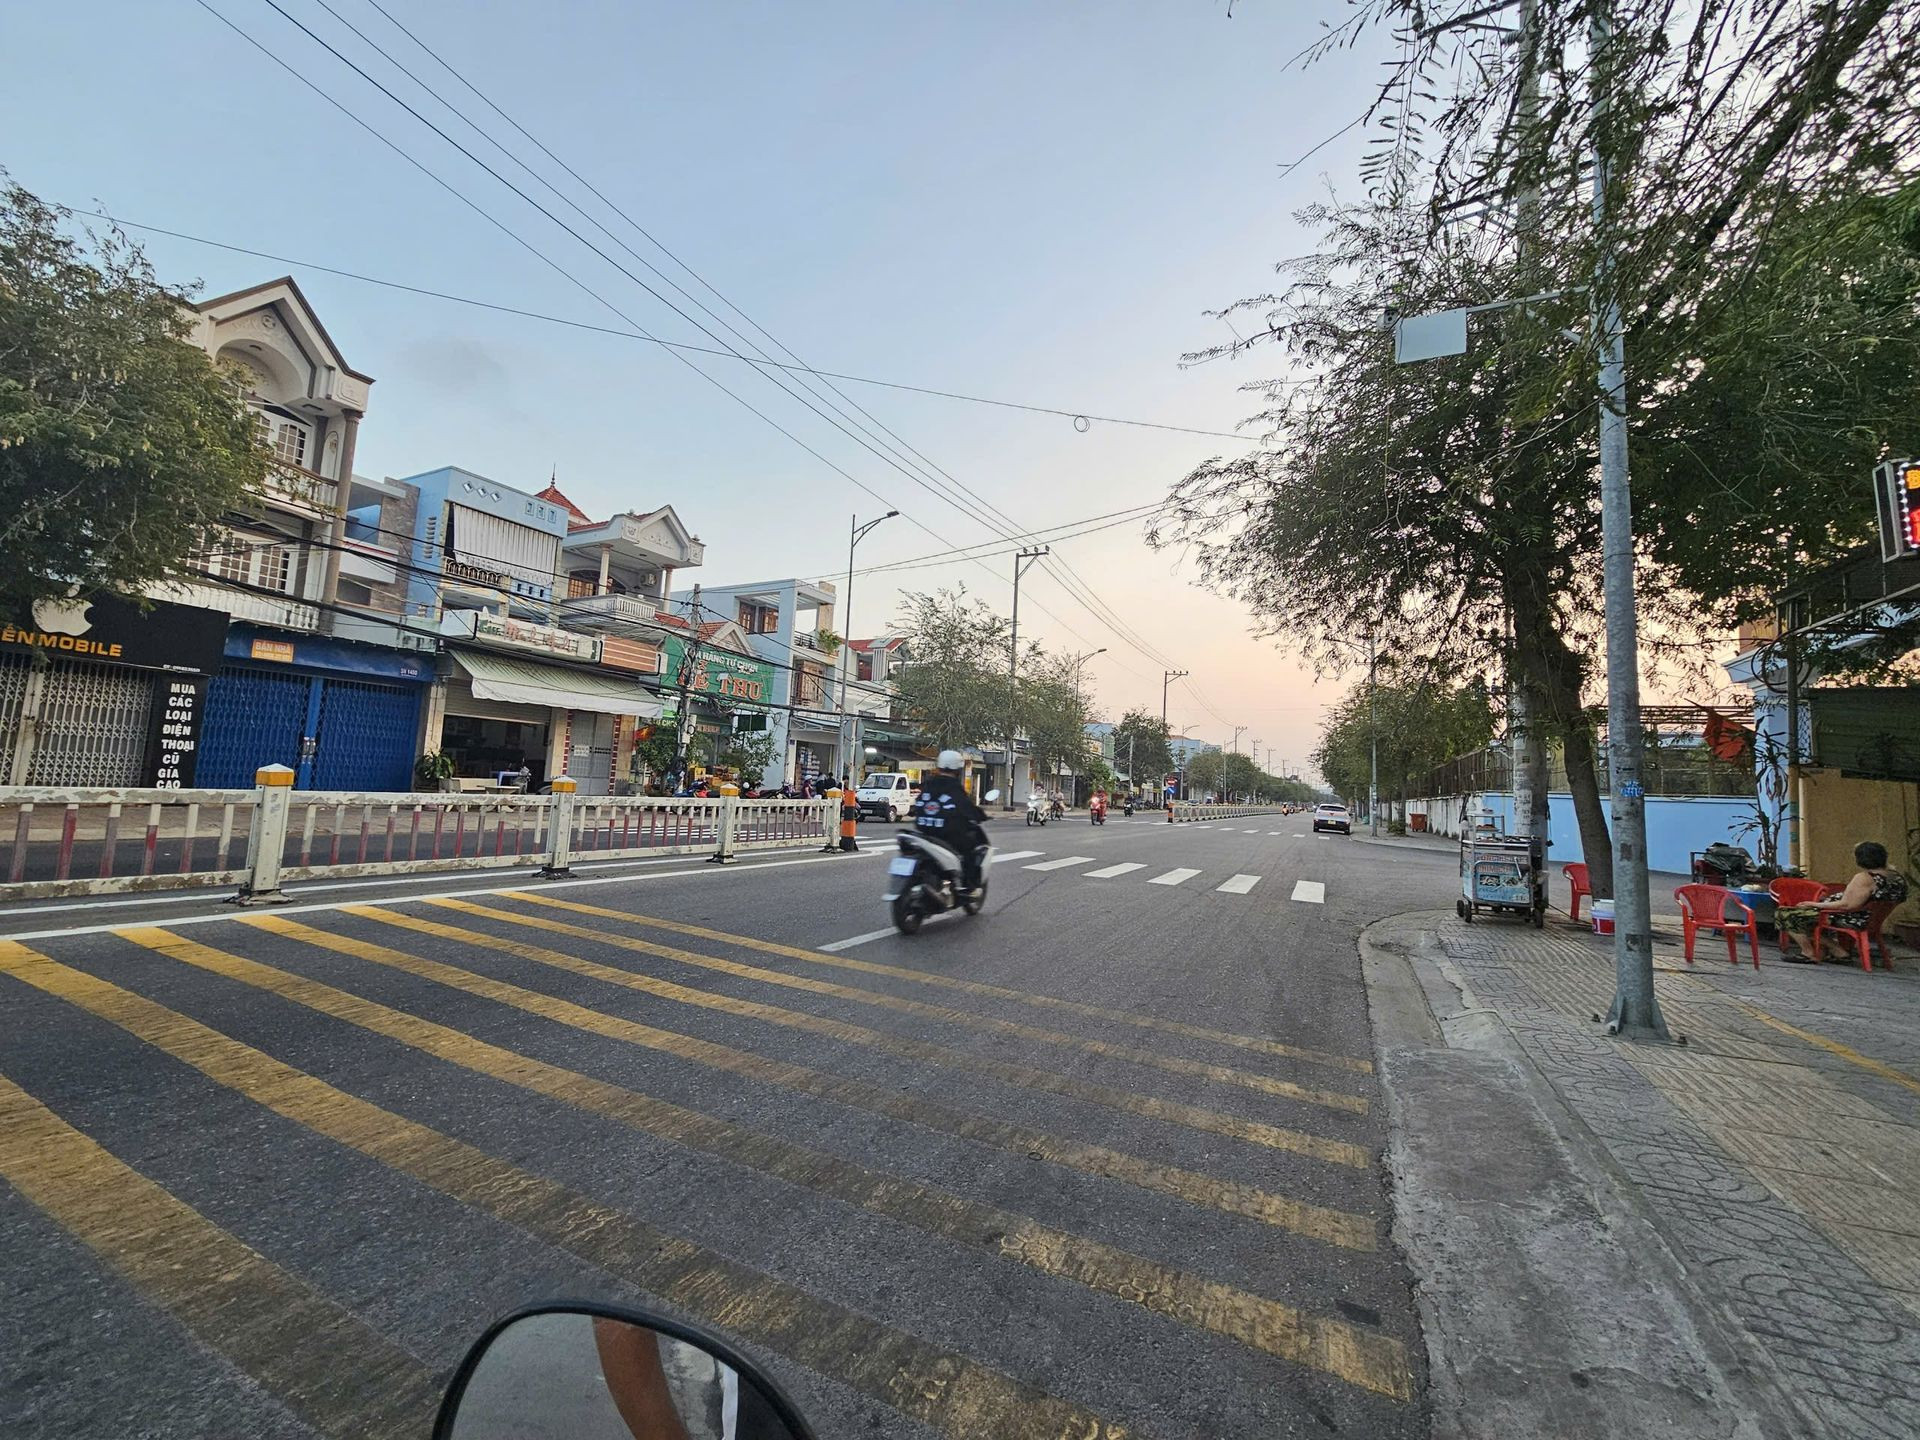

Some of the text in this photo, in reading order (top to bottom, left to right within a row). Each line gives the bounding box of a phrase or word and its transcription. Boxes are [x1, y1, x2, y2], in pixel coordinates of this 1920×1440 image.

[37, 633, 124, 657] MOBILE
[170, 683, 196, 695] MUA
[716, 672, 764, 701] THU
[168, 694, 194, 708] CÁC
[165, 709, 192, 723] LOẠI
[162, 722, 192, 737] ĐIỆN
[161, 739, 196, 752] THOẠI
[162, 752, 180, 765] CŨ
[156, 779, 181, 790] CAO
